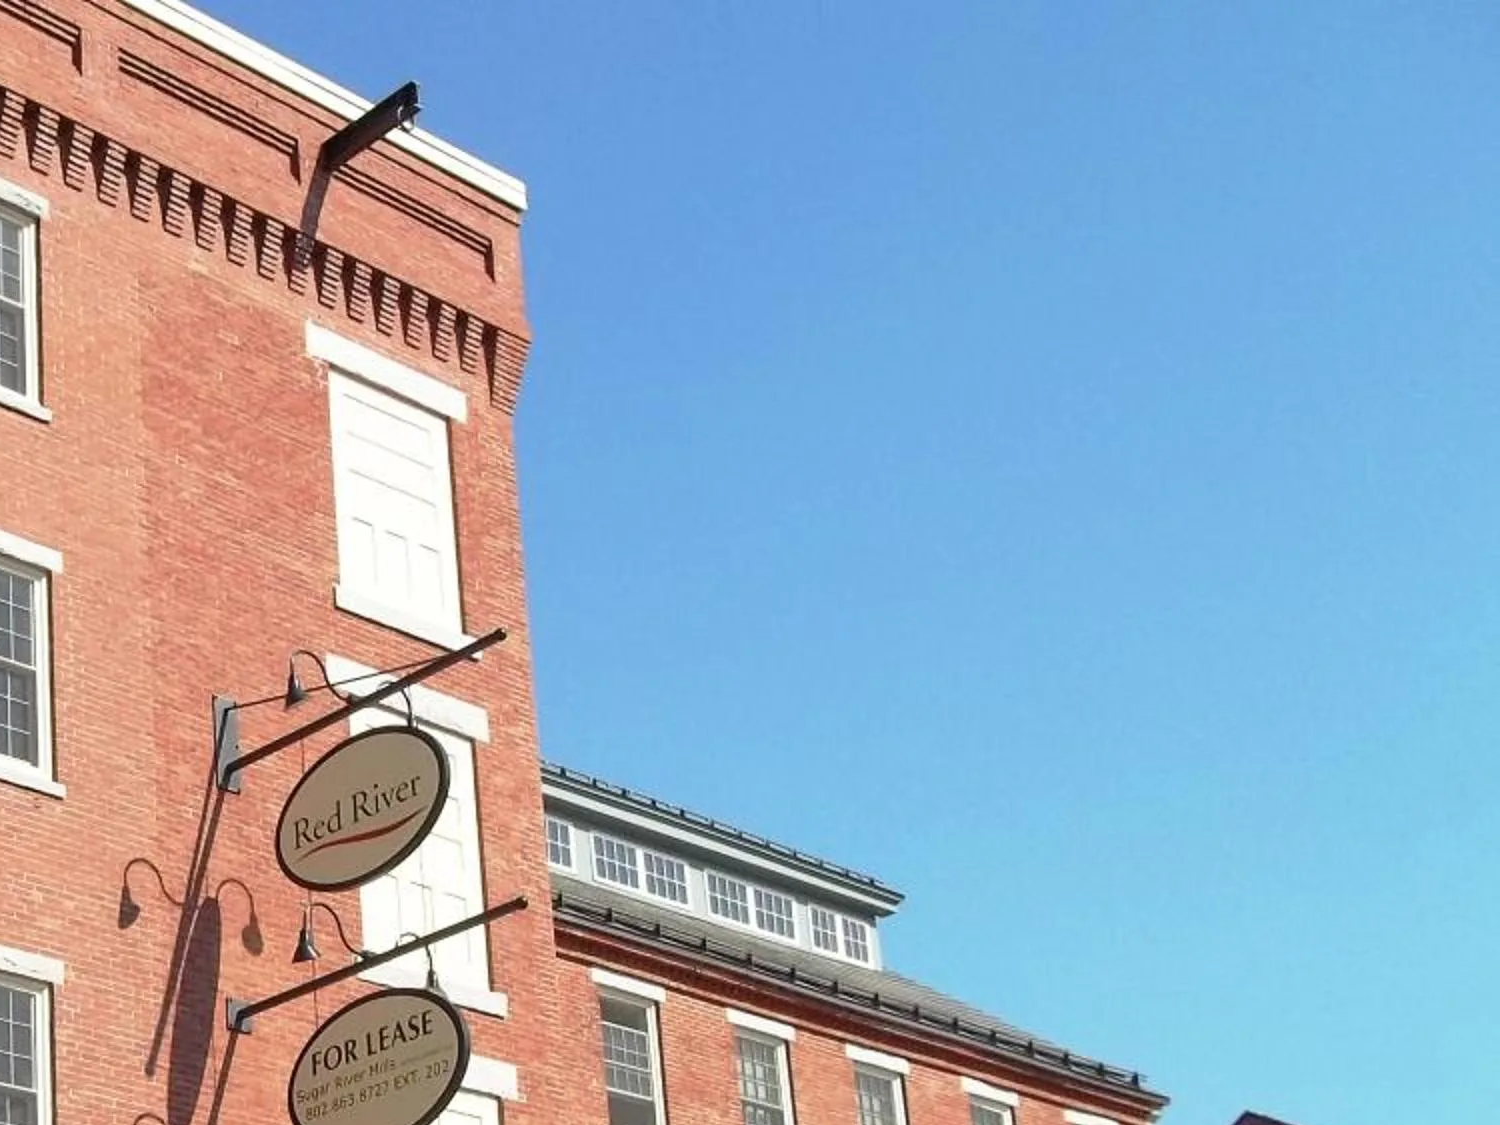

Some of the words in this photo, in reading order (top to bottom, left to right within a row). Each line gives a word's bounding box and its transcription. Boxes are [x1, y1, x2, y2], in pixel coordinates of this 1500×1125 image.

[294, 801, 342, 849] Red
[351, 775, 421, 822] River
[311, 1039, 358, 1076] FOR
[366, 1010, 434, 1057] LEASE
[334, 1070, 366, 1089] River
